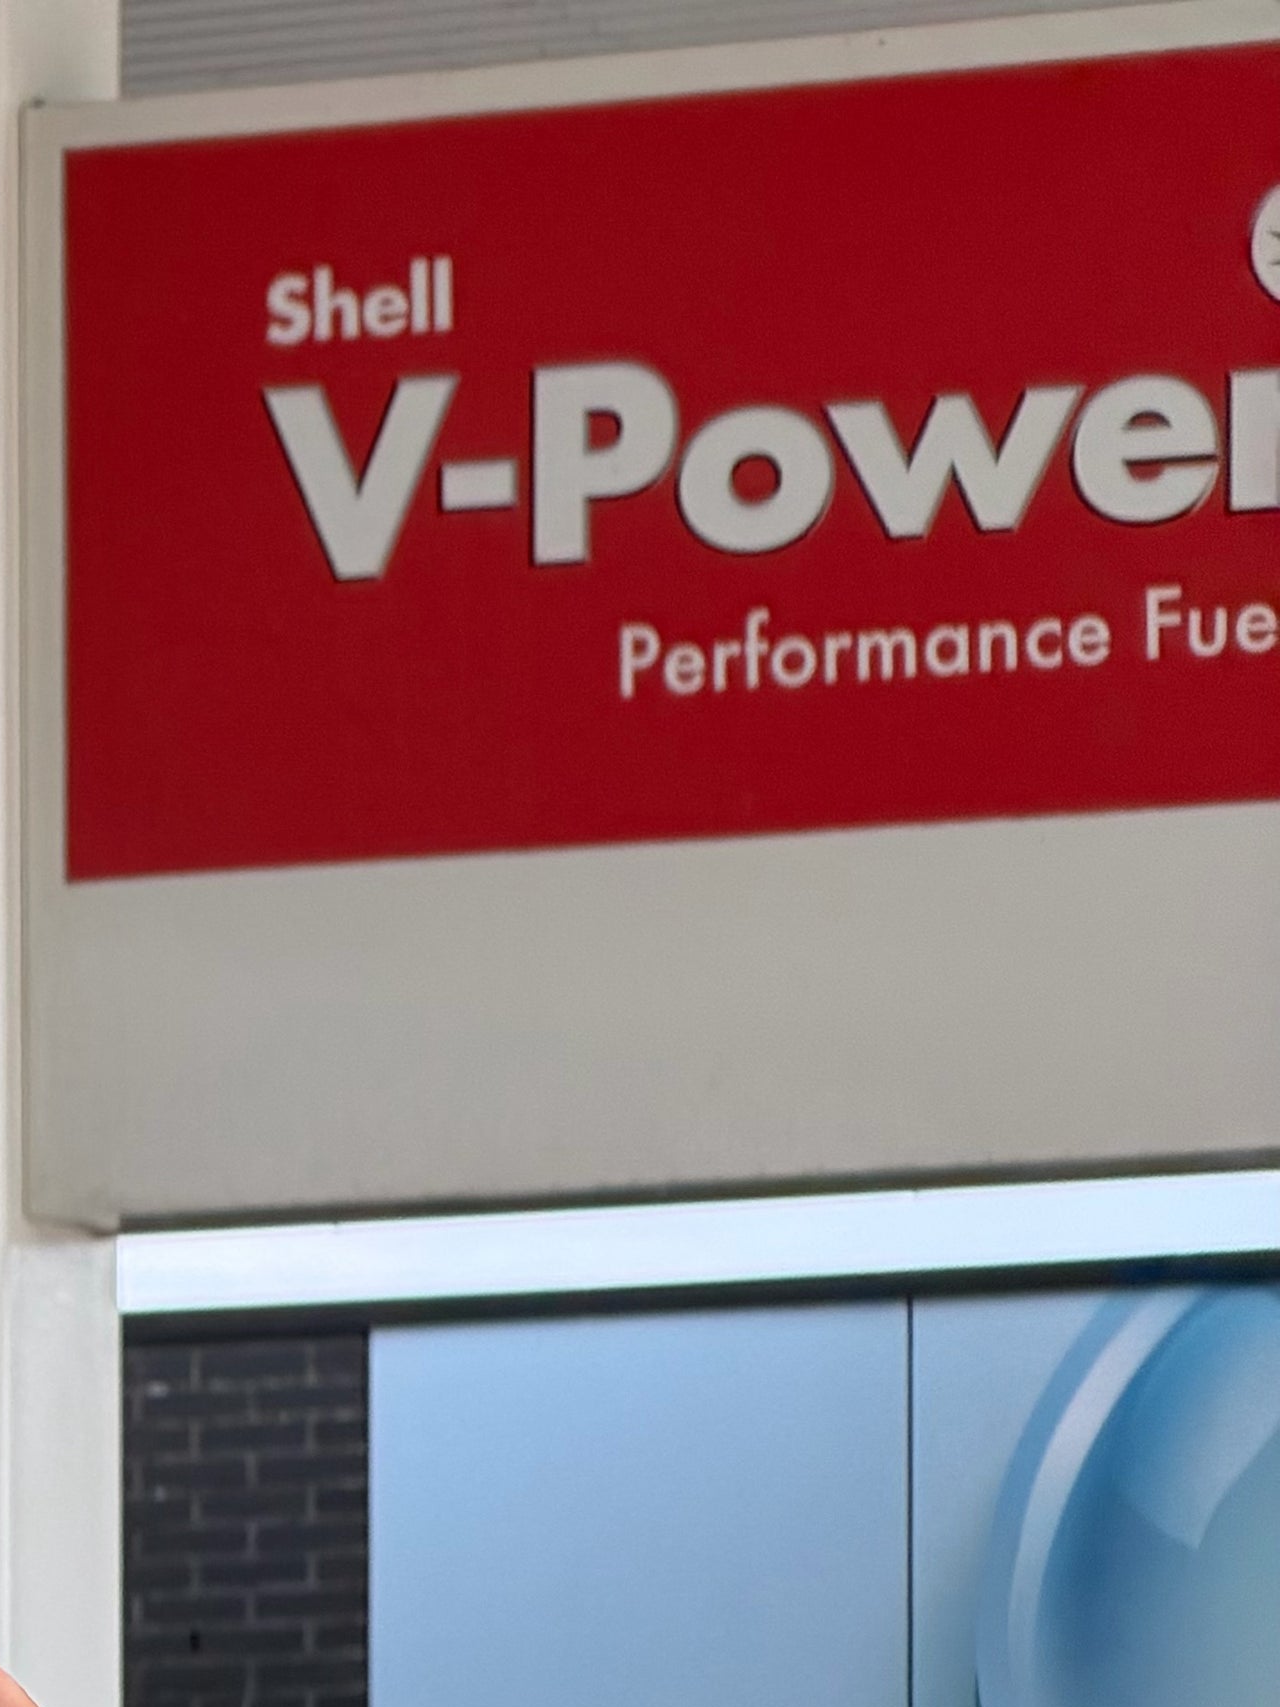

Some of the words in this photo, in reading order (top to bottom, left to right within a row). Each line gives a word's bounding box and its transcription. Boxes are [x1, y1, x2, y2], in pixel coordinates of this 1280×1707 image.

[265, 256, 453, 346] Shell
[261, 360, 1280, 582] V-Power
[619, 607, 1111, 699] Performance
